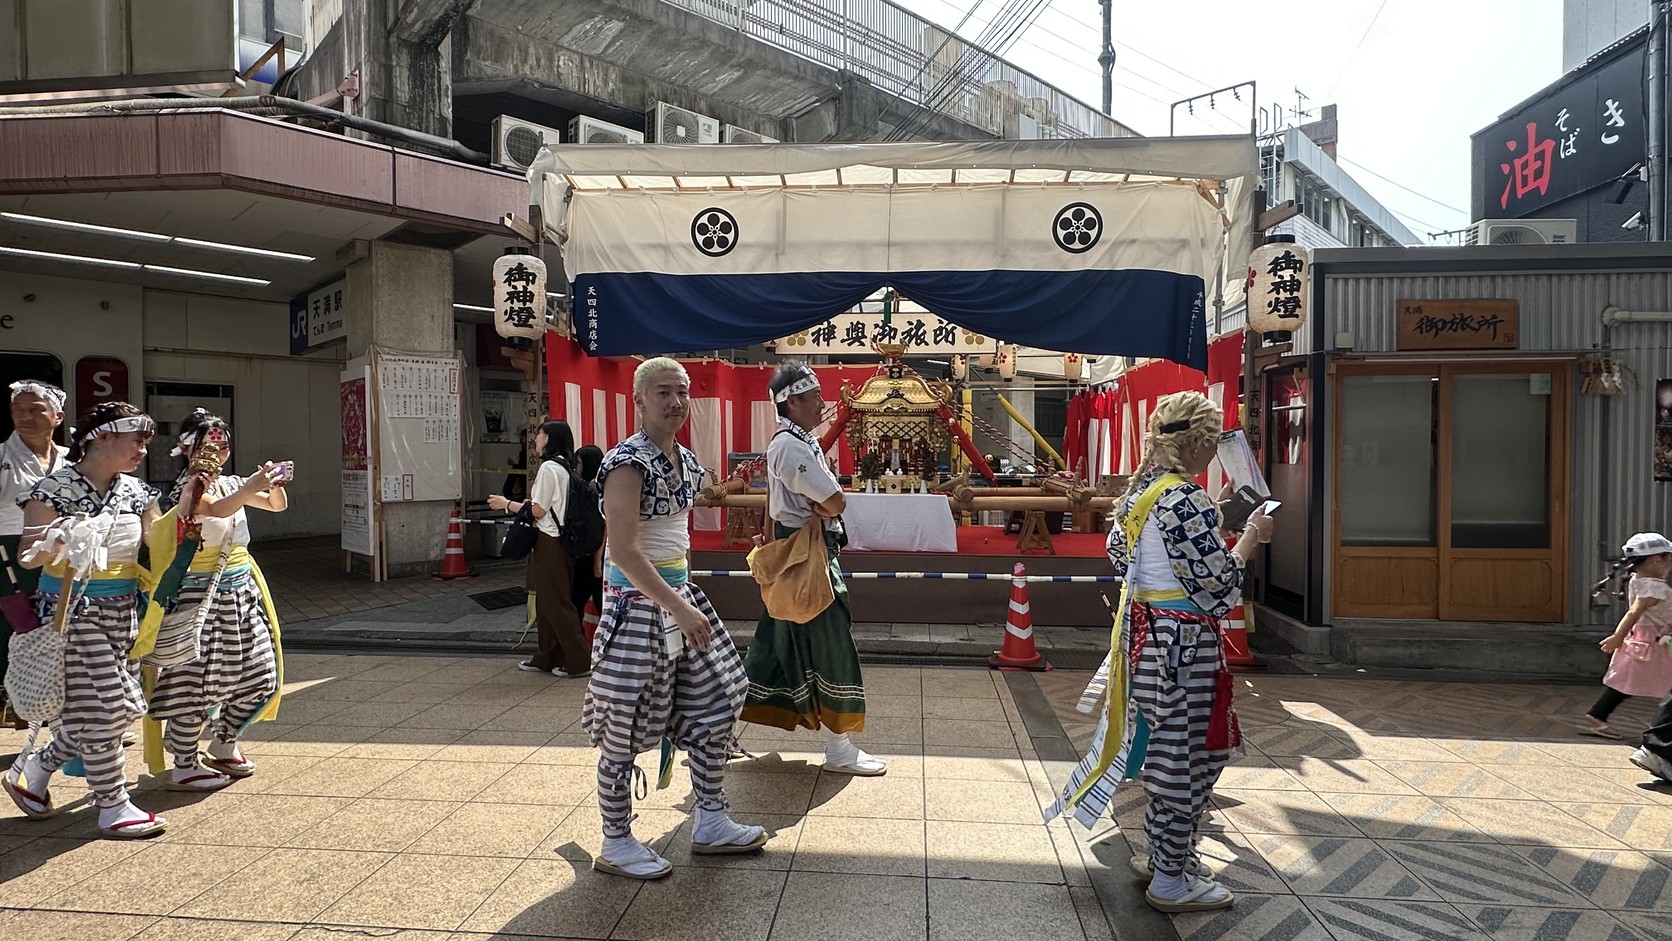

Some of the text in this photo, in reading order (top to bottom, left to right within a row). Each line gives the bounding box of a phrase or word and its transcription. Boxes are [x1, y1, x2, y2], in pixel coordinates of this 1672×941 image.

[313, 289, 343, 320] 天満駅
[503, 262, 537, 329] 御神燈
[1266, 250, 1304, 319] 御神燈
[292, 309, 306, 338] JR
[587, 286, 598, 351] 天四北商店会
[1412, 312, 1505, 342] 御旅所
[92, 371, 113, 397] S
[528, 392, 537, 481] 天四北商店会
